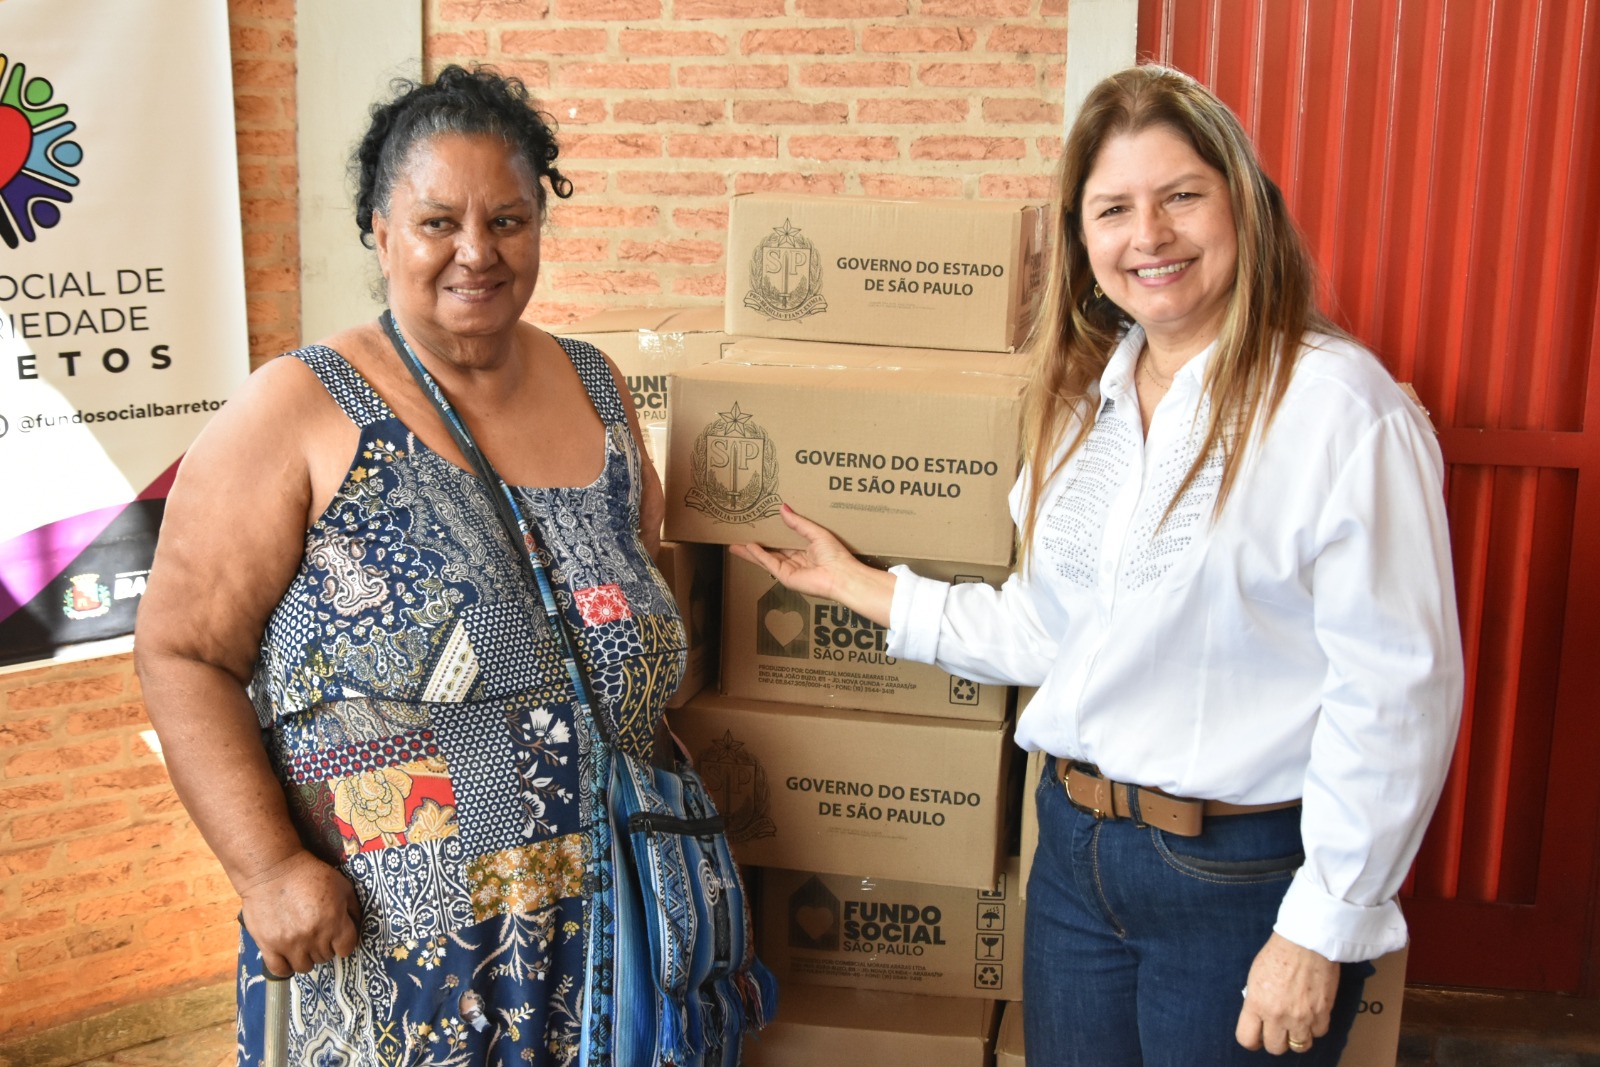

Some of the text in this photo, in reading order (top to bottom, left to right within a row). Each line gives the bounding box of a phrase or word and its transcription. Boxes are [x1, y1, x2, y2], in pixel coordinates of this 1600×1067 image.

[836, 257, 1004, 277] GOVERNO DO ESTADO
[117, 268, 165, 295] DE
[864, 277, 973, 296] DE SÃO PAULO
[795, 449, 998, 476] GOVERNO DO ESTADO
[829, 475, 961, 499] DE SÃO PAULO
[814, 626, 889, 652] SOCI
[813, 647, 897, 665] SÃO PAULO
[786, 776, 981, 806] GOVERNO DO ESTADO
[818, 802, 945, 826] DE SÃO PAULO
[843, 901, 941, 925] FUNDO
[843, 922, 946, 945] SOCIAL
[843, 939, 924, 956] SÃO PAULO
